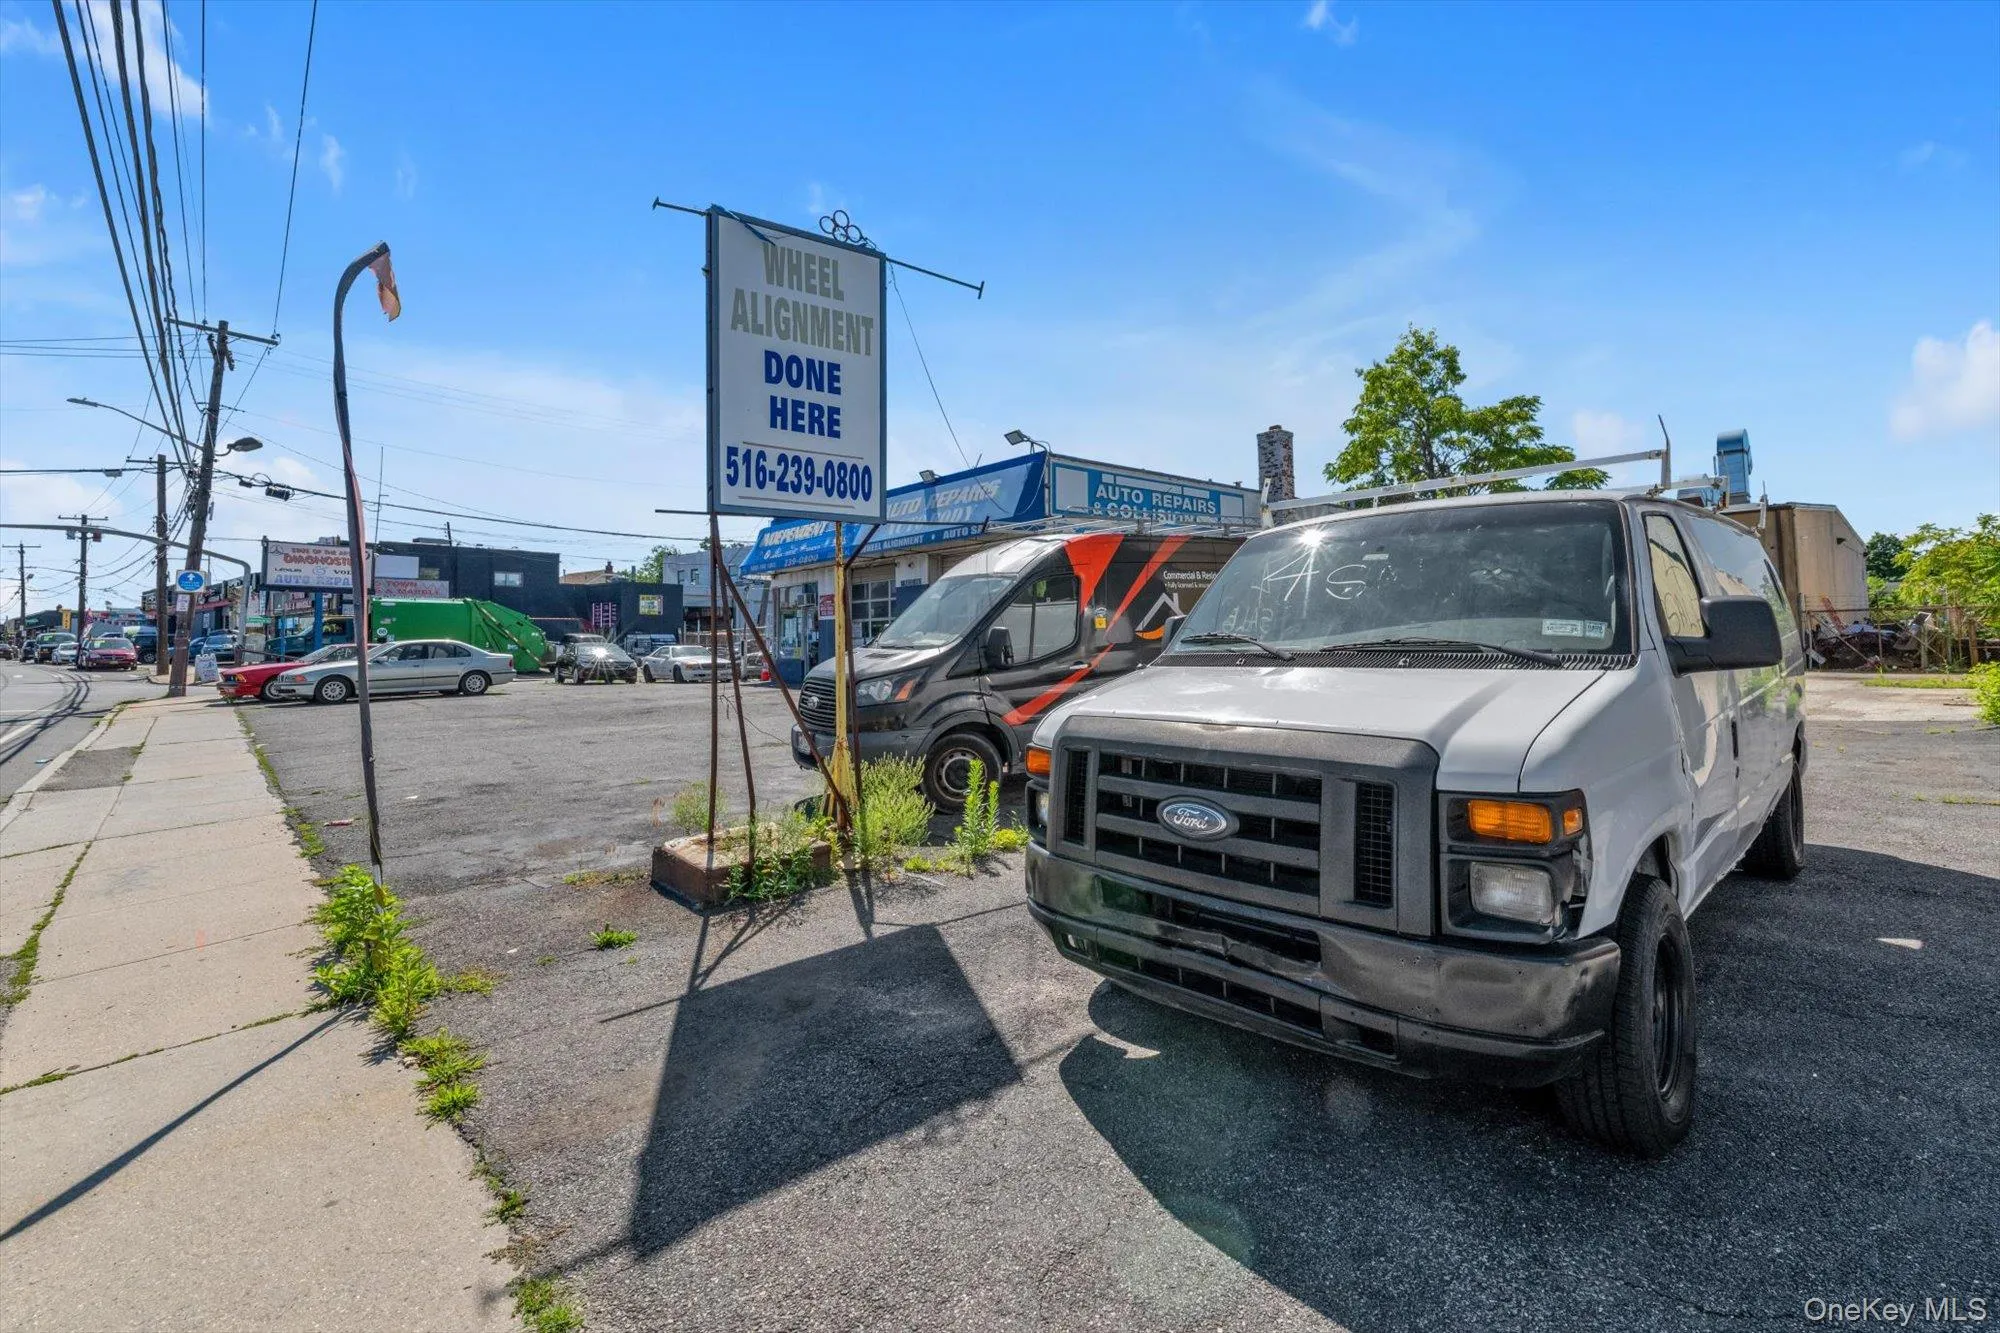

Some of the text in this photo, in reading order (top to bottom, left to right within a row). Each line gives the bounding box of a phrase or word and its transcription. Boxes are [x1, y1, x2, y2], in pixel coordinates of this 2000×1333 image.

[762, 242, 845, 302] WHEEL
[730, 287, 874, 357] ALIGNMENT
[763, 349, 842, 396] DONE
[769, 395, 842, 439] HERE
[725, 445, 873, 502] 516-239-0800
[1096, 484, 1217, 514] AUTO REPAIRS
[882, 535, 924, 550] ALIGNMENT
[943, 528, 969, 540] AUTO
[1173, 807, 1209, 830] Ford
